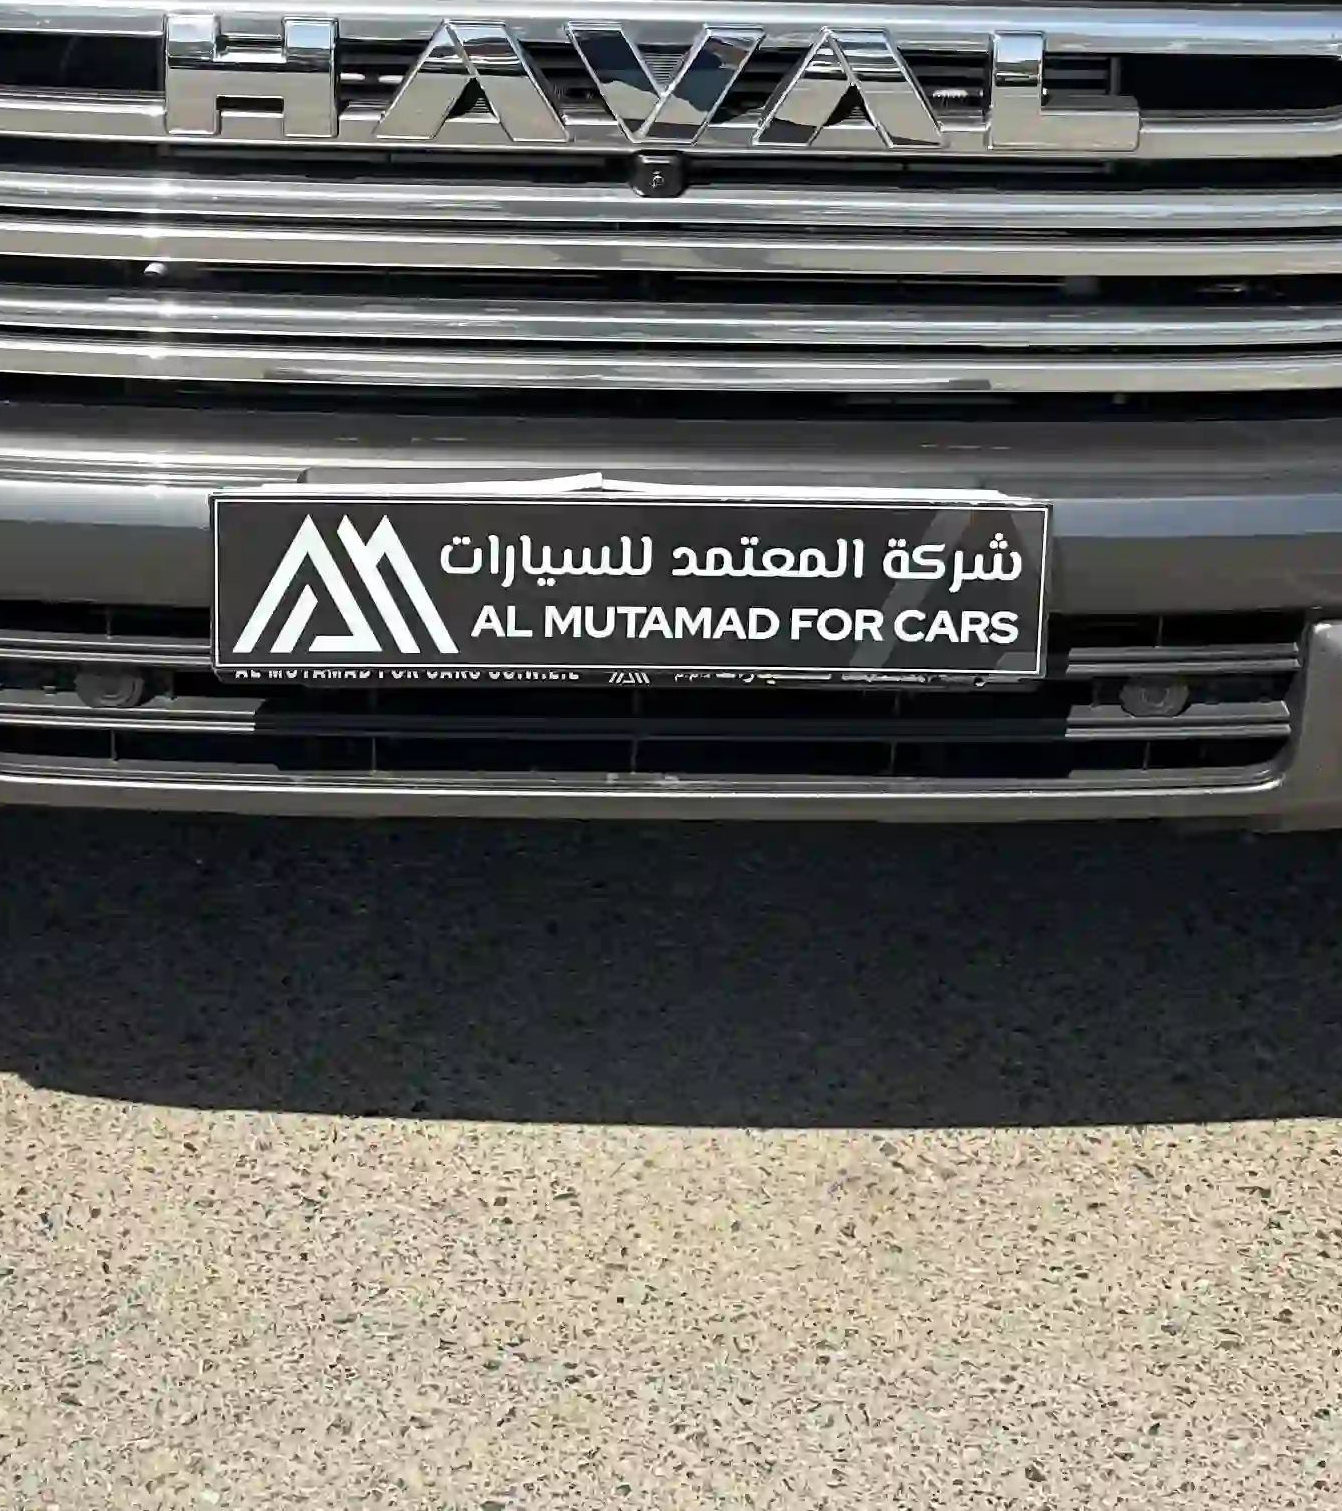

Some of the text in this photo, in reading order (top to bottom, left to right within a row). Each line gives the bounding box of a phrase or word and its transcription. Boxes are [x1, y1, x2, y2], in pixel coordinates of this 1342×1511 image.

[163, 13, 1141, 151] HAVAL
[440, 532, 1023, 594] شركة المعتمد للسيارات
[470, 605, 1019, 644] AL MUTAMAD FOR CARS
